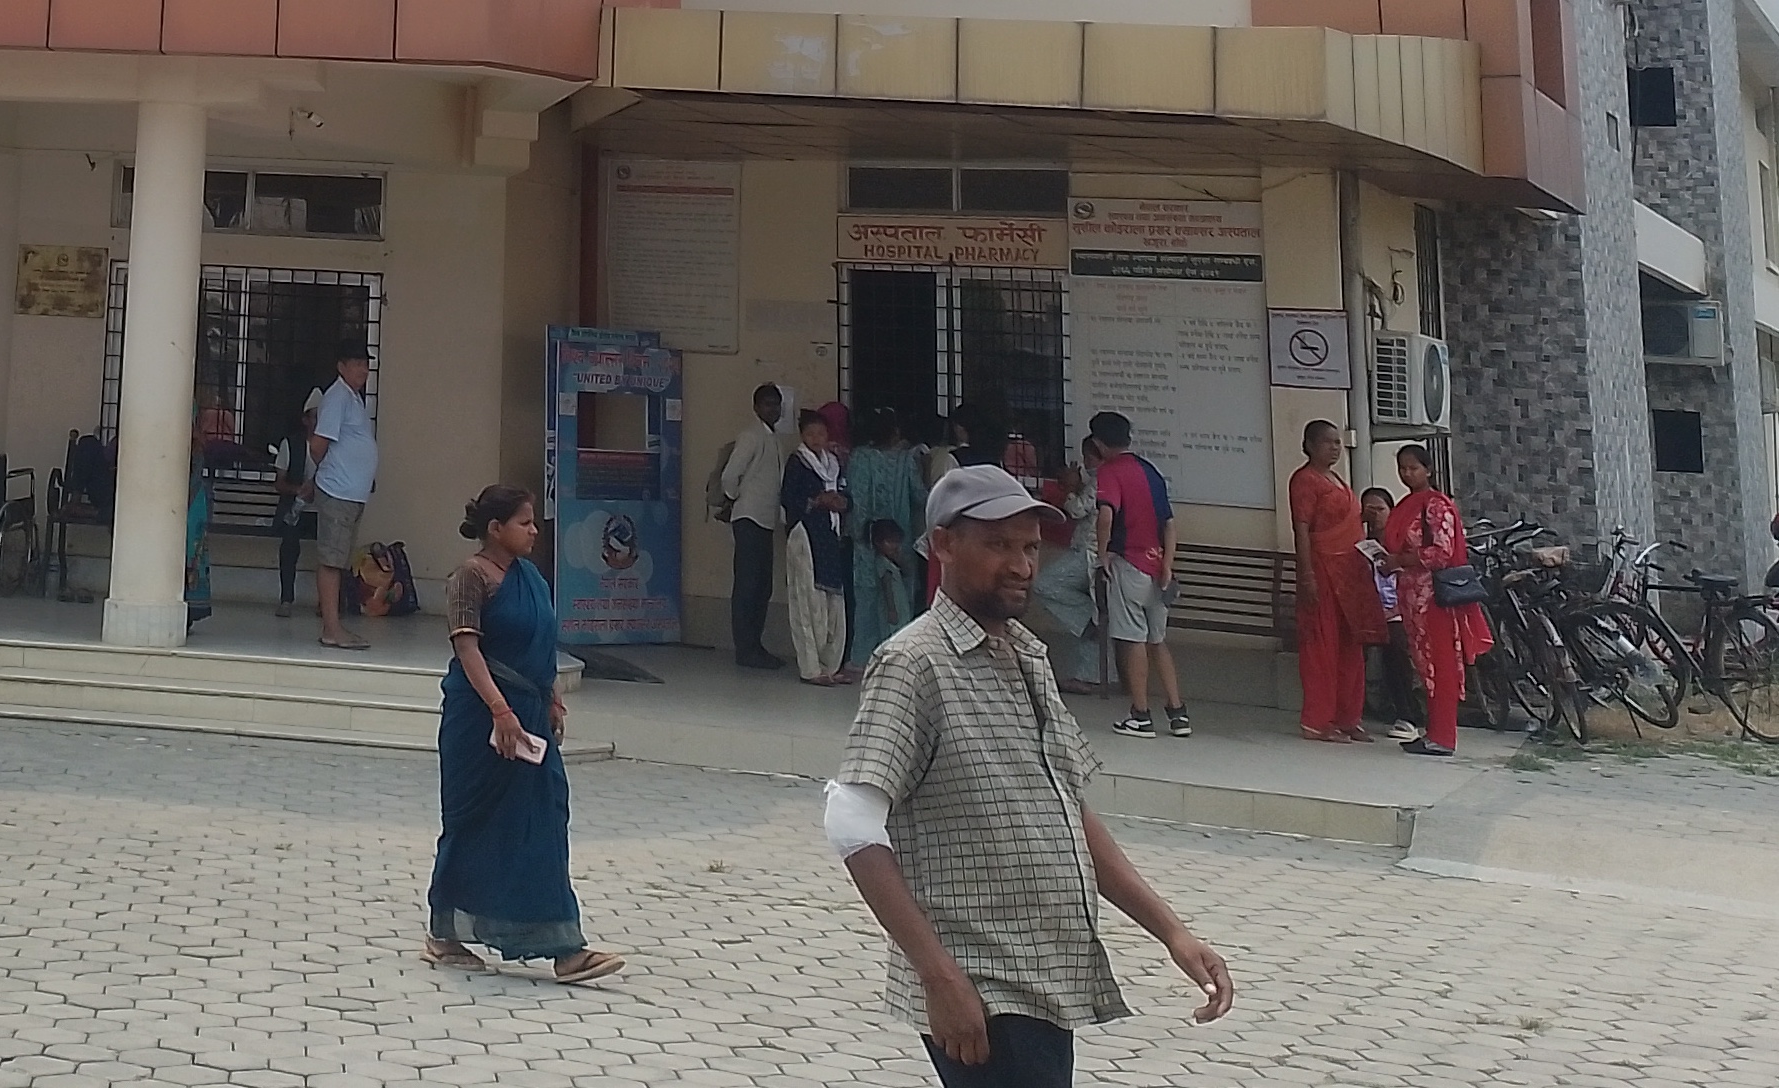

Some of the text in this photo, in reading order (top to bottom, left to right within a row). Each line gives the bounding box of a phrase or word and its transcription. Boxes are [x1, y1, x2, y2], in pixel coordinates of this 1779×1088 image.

[847, 223, 946, 244] अस्पताल
[863, 244, 1041, 263] HOSPITAL PHARMACY
